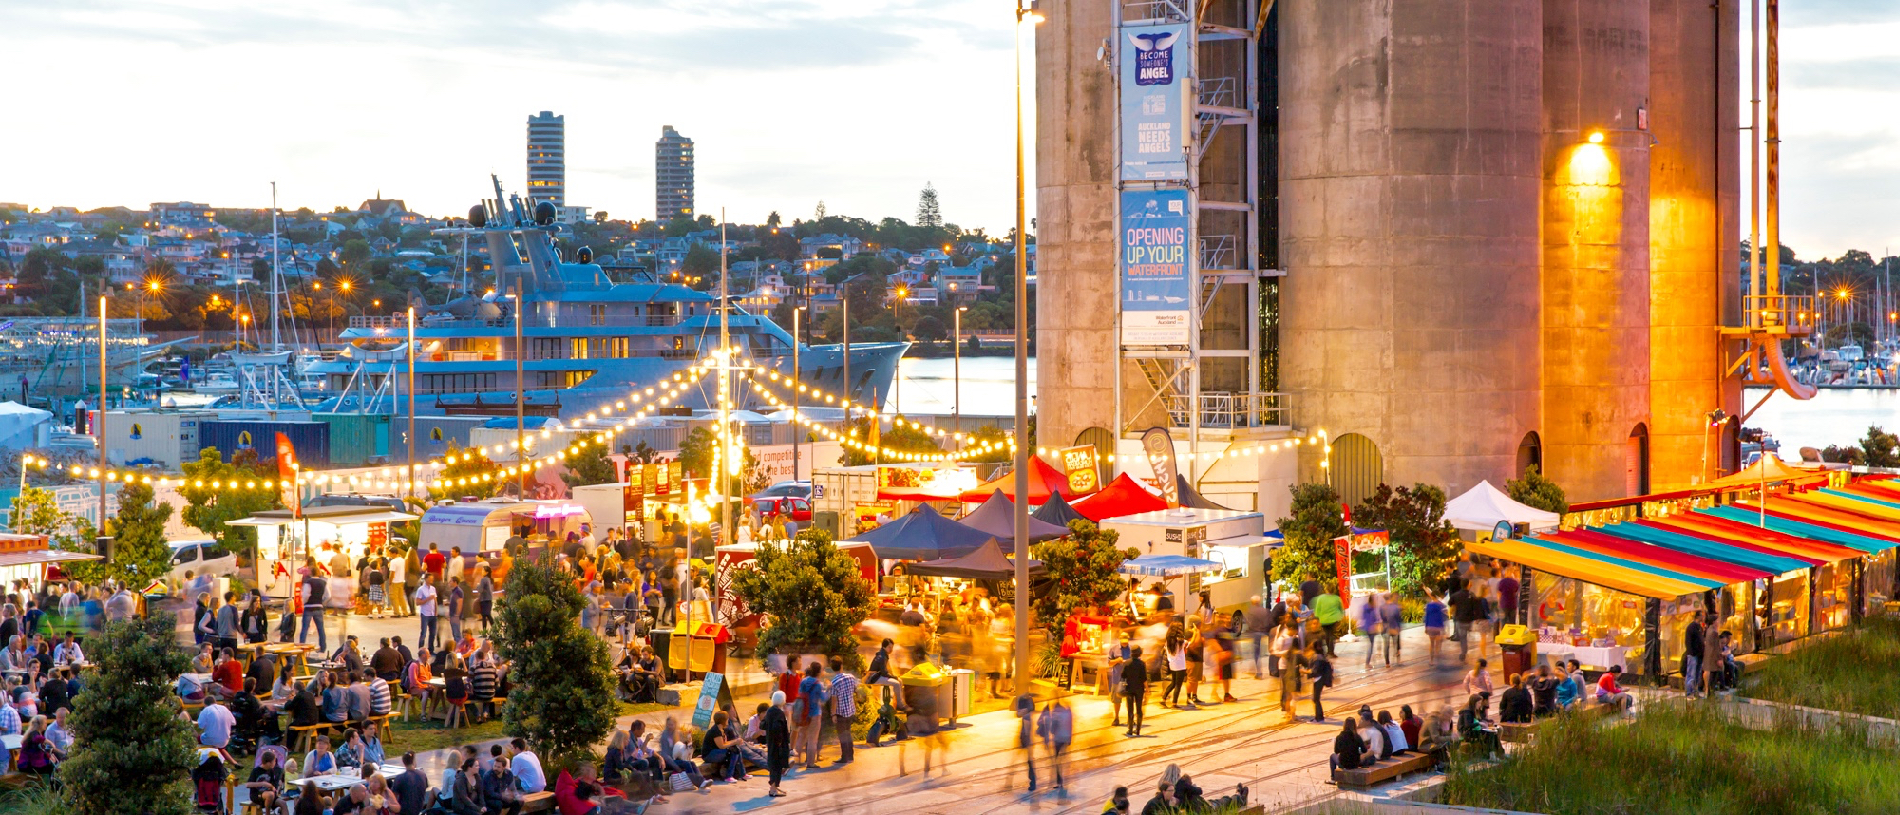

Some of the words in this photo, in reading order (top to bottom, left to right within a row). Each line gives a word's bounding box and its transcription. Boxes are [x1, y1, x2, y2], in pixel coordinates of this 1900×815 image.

[1140, 51, 1168, 60] BECOME
[1140, 60, 1169, 68] SOMEONE'S
[1140, 67, 1169, 79] ANGEL
[1138, 123, 1171, 131] AUCKLAND
[1138, 130, 1171, 143] NEEDS
[1138, 142, 1171, 153] ANGELS
[1127, 227, 1184, 246] OPENING
[1127, 246, 1145, 264] UP
[1146, 245, 1184, 263] YOUR
[1127, 263, 1184, 276] WATERFRONT
[764, 448, 802, 464] competitie
[425, 469, 437, 484] of
[426, 515, 451, 524] Burger
[1166, 532, 1182, 541] SUSHI
